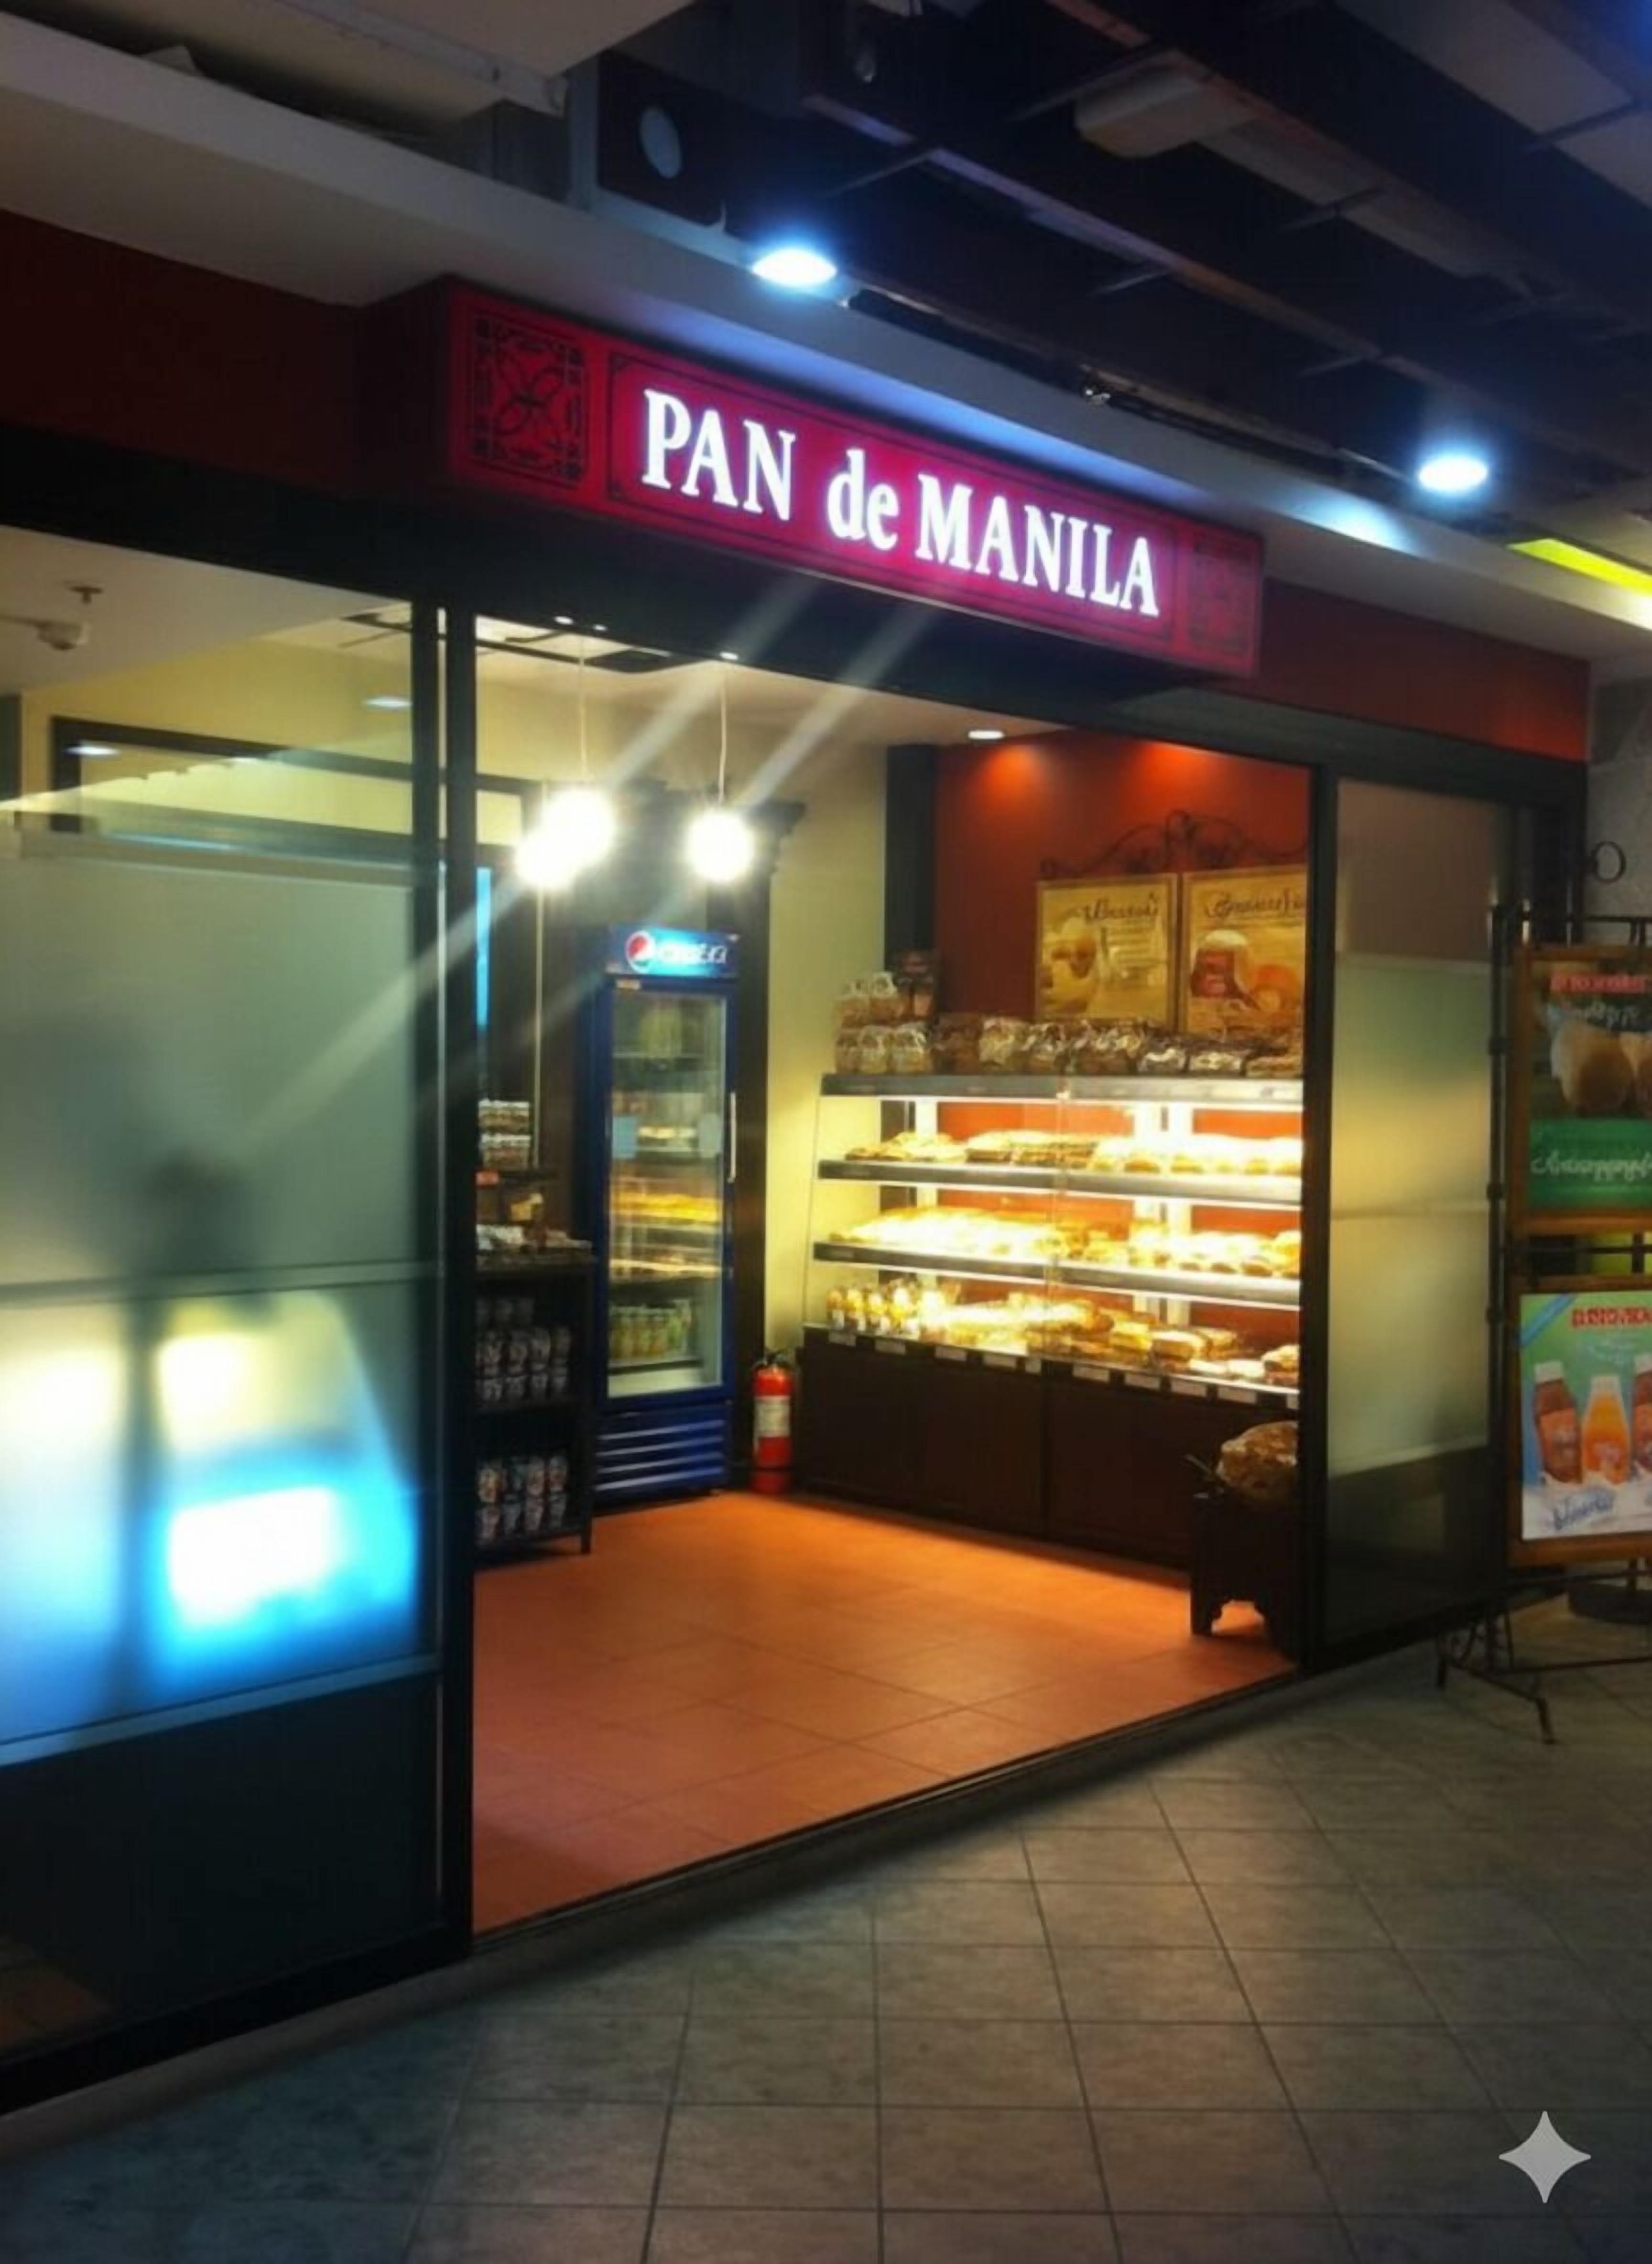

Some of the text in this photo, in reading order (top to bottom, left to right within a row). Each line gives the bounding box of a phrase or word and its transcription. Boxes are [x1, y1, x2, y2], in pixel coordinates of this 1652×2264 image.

[642, 389, 1160, 618] PAN de MANILA
